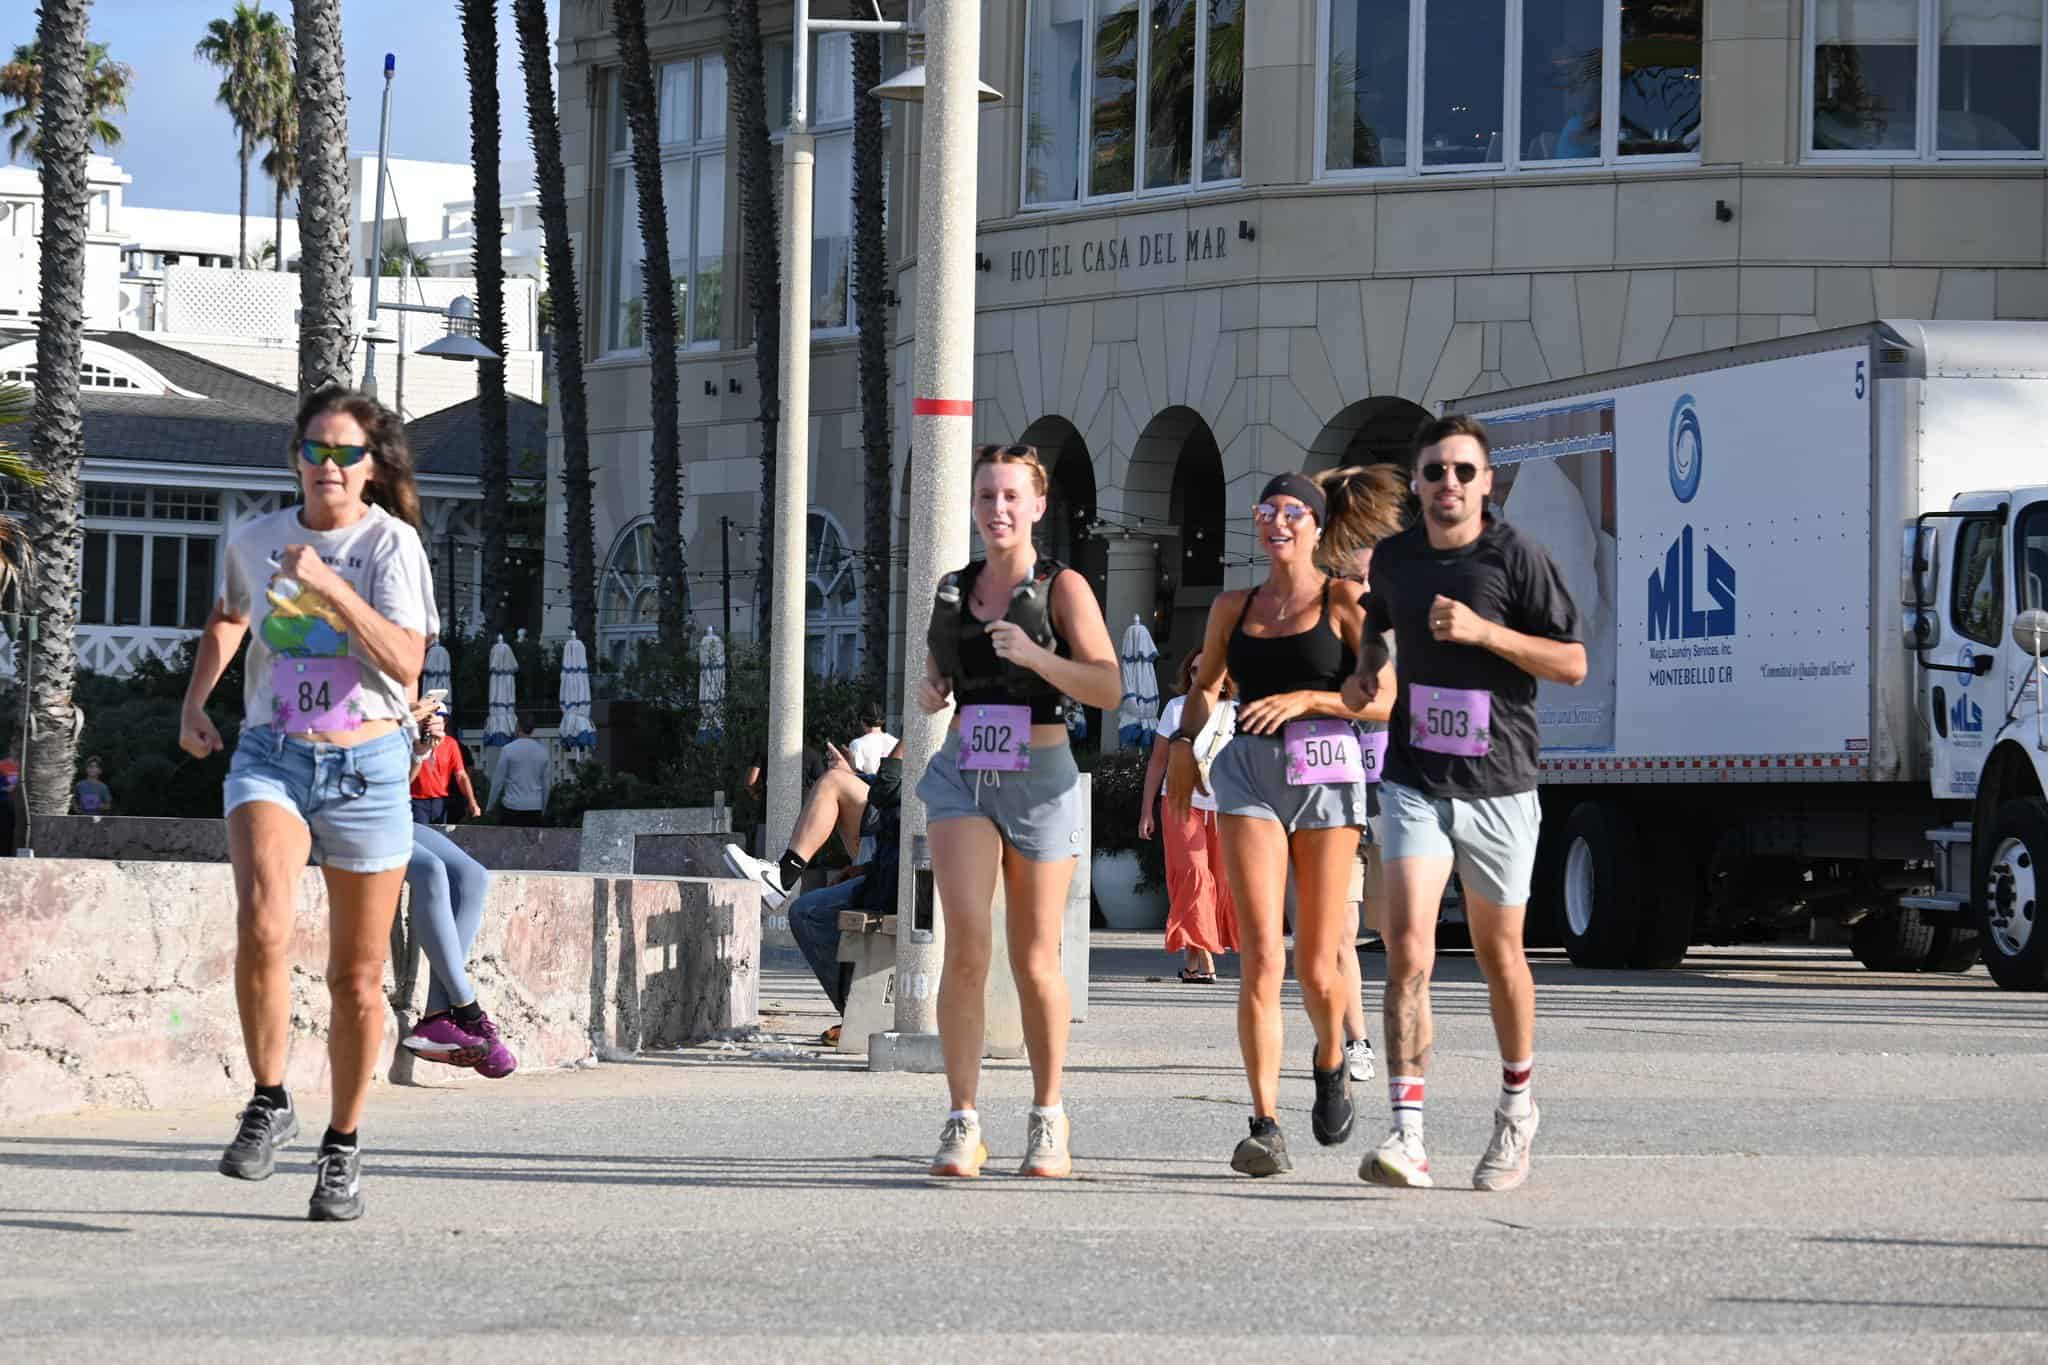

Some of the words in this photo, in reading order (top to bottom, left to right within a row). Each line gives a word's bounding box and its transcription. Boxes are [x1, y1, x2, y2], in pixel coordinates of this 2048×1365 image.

[1010, 245, 1072, 282] HOTEL
[1082, 237, 1129, 272] CASA
[1139, 232, 1177, 266] DEL
[1185, 226, 1226, 261] MAR
[1854, 361, 1866, 399] 5
[1647, 523, 1737, 641] MLS
[1649, 665, 1715, 687] MONTEBELLO
[1718, 665, 1733, 684] CA
[297, 680, 332, 713] 84
[1951, 692, 1983, 732] MLS
[971, 725, 1012, 753] 502
[1426, 707, 1469, 738] 503
[1305, 739, 1347, 767] 504
